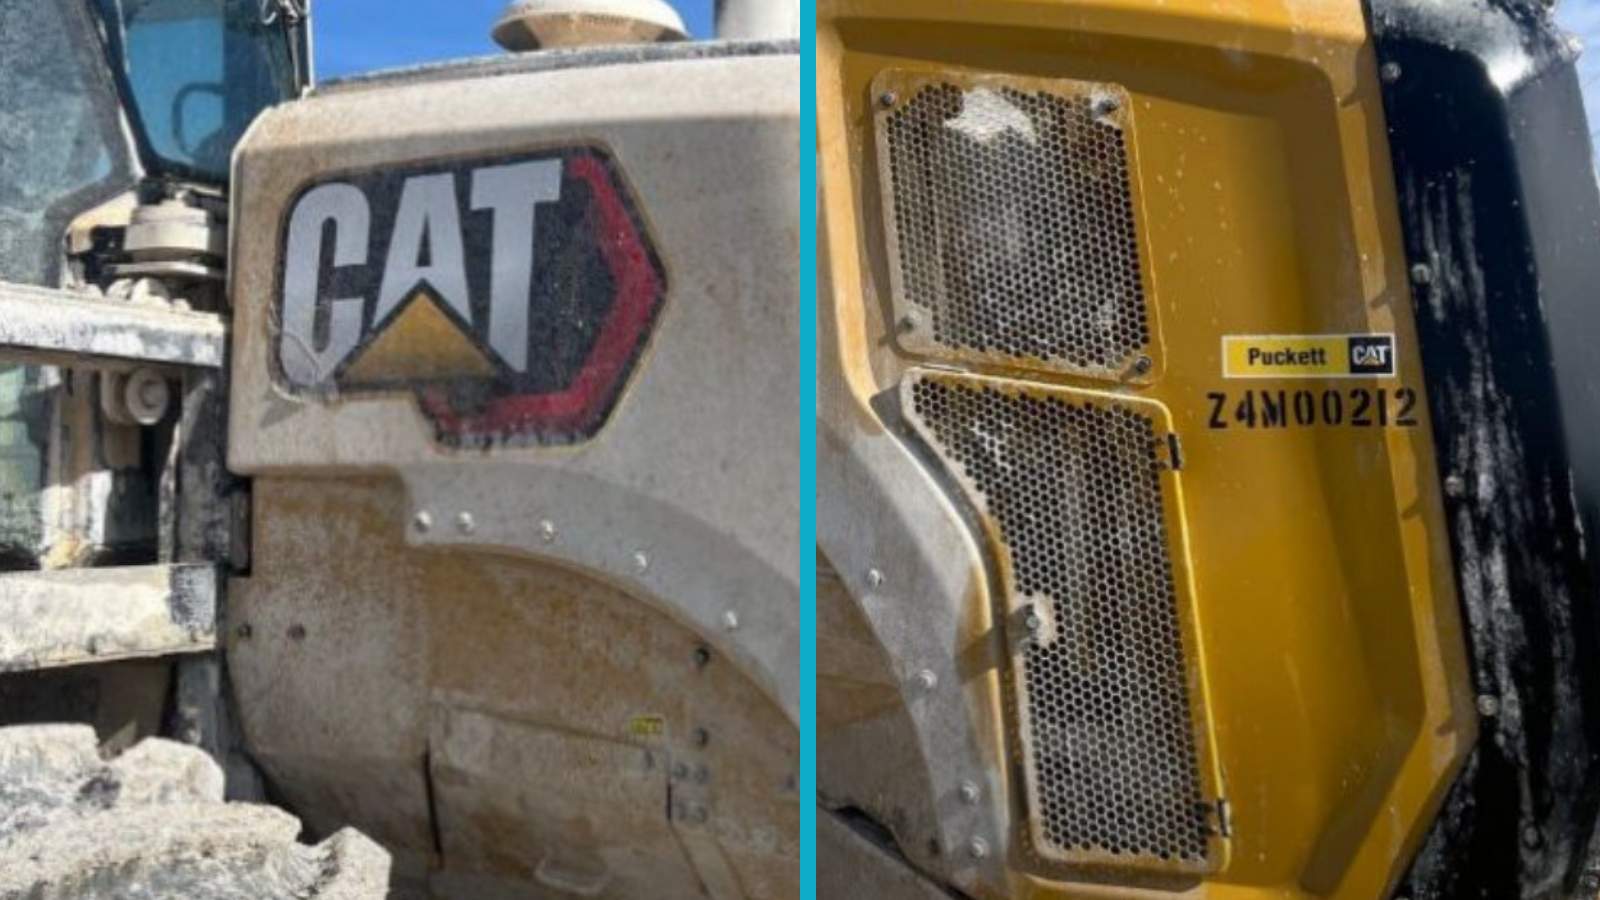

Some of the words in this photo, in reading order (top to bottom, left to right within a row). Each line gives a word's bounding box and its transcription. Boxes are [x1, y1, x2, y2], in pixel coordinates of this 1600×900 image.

[280, 158, 563, 387] CAT
[1248, 347, 1327, 366] Puckett
[1352, 345, 1391, 366] CAT
